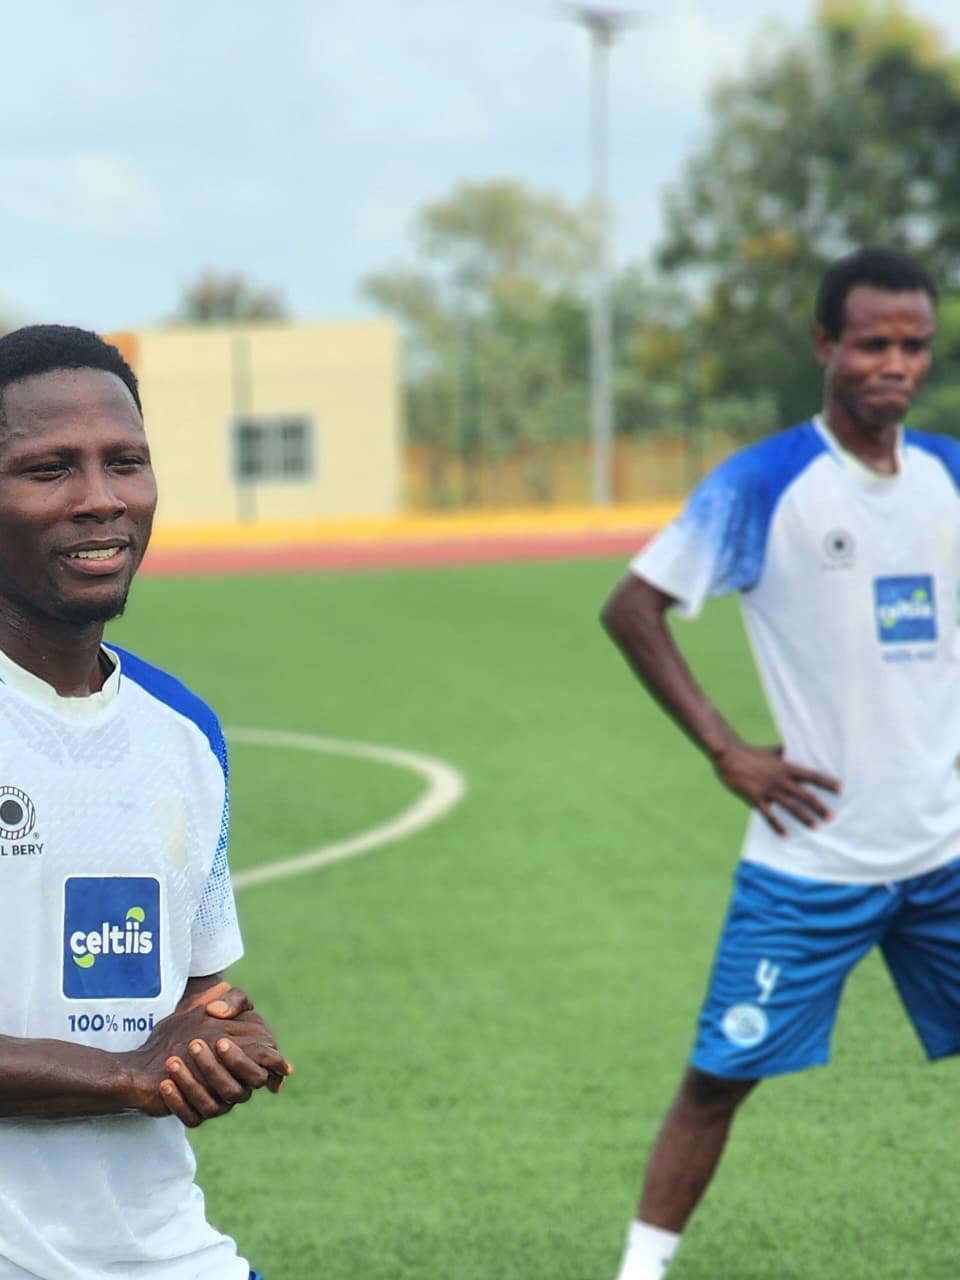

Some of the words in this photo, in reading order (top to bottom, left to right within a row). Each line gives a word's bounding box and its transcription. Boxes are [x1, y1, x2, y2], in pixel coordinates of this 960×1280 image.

[12, 843, 44, 857] BERY
[70, 921, 153, 955] celtiis
[68, 1013, 119, 1032] 100%
[122, 1012, 154, 1032] moi
